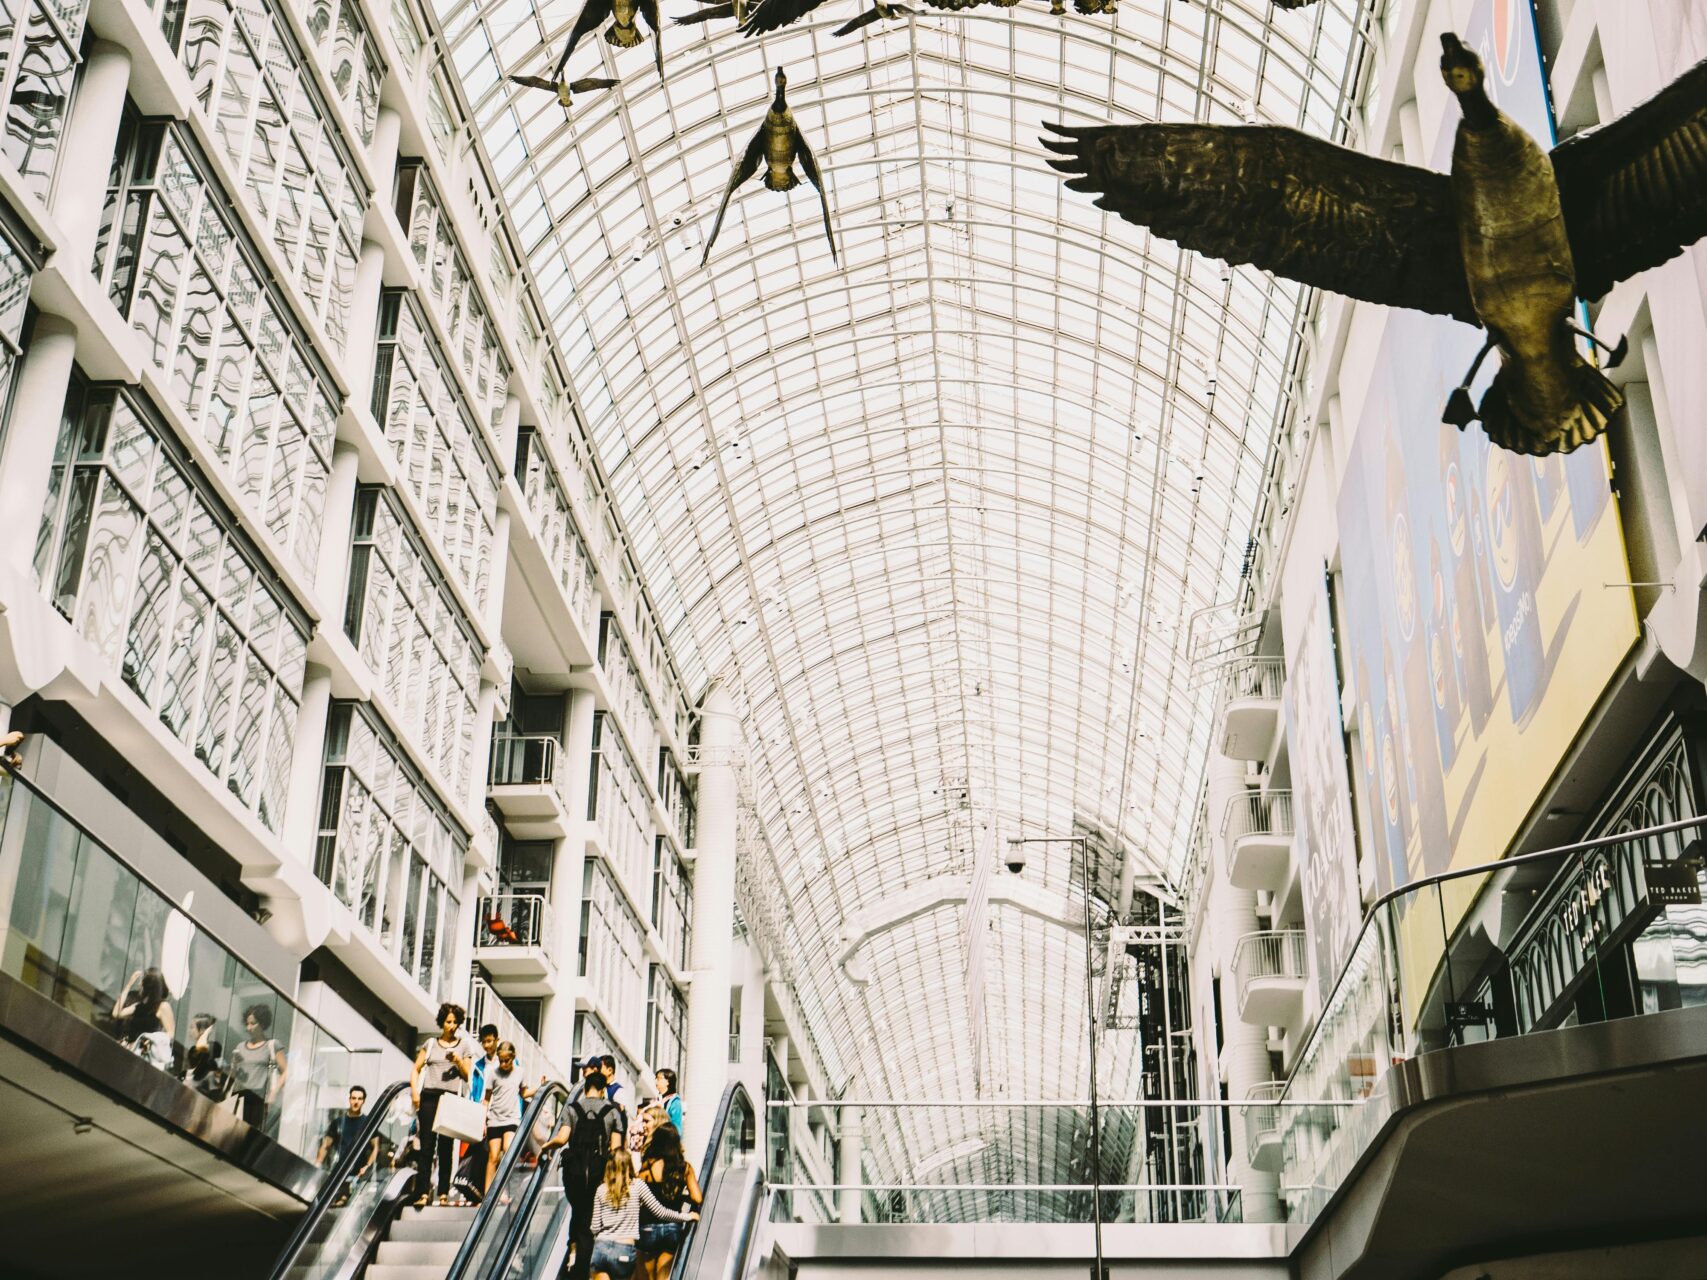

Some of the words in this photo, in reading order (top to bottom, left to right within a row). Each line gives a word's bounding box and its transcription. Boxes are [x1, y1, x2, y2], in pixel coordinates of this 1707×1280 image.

[1305, 790, 1344, 913] COACH
[1649, 886, 1666, 894] TED
[1670, 886, 1697, 894] BAKER
[1563, 901, 1579, 936] TED
